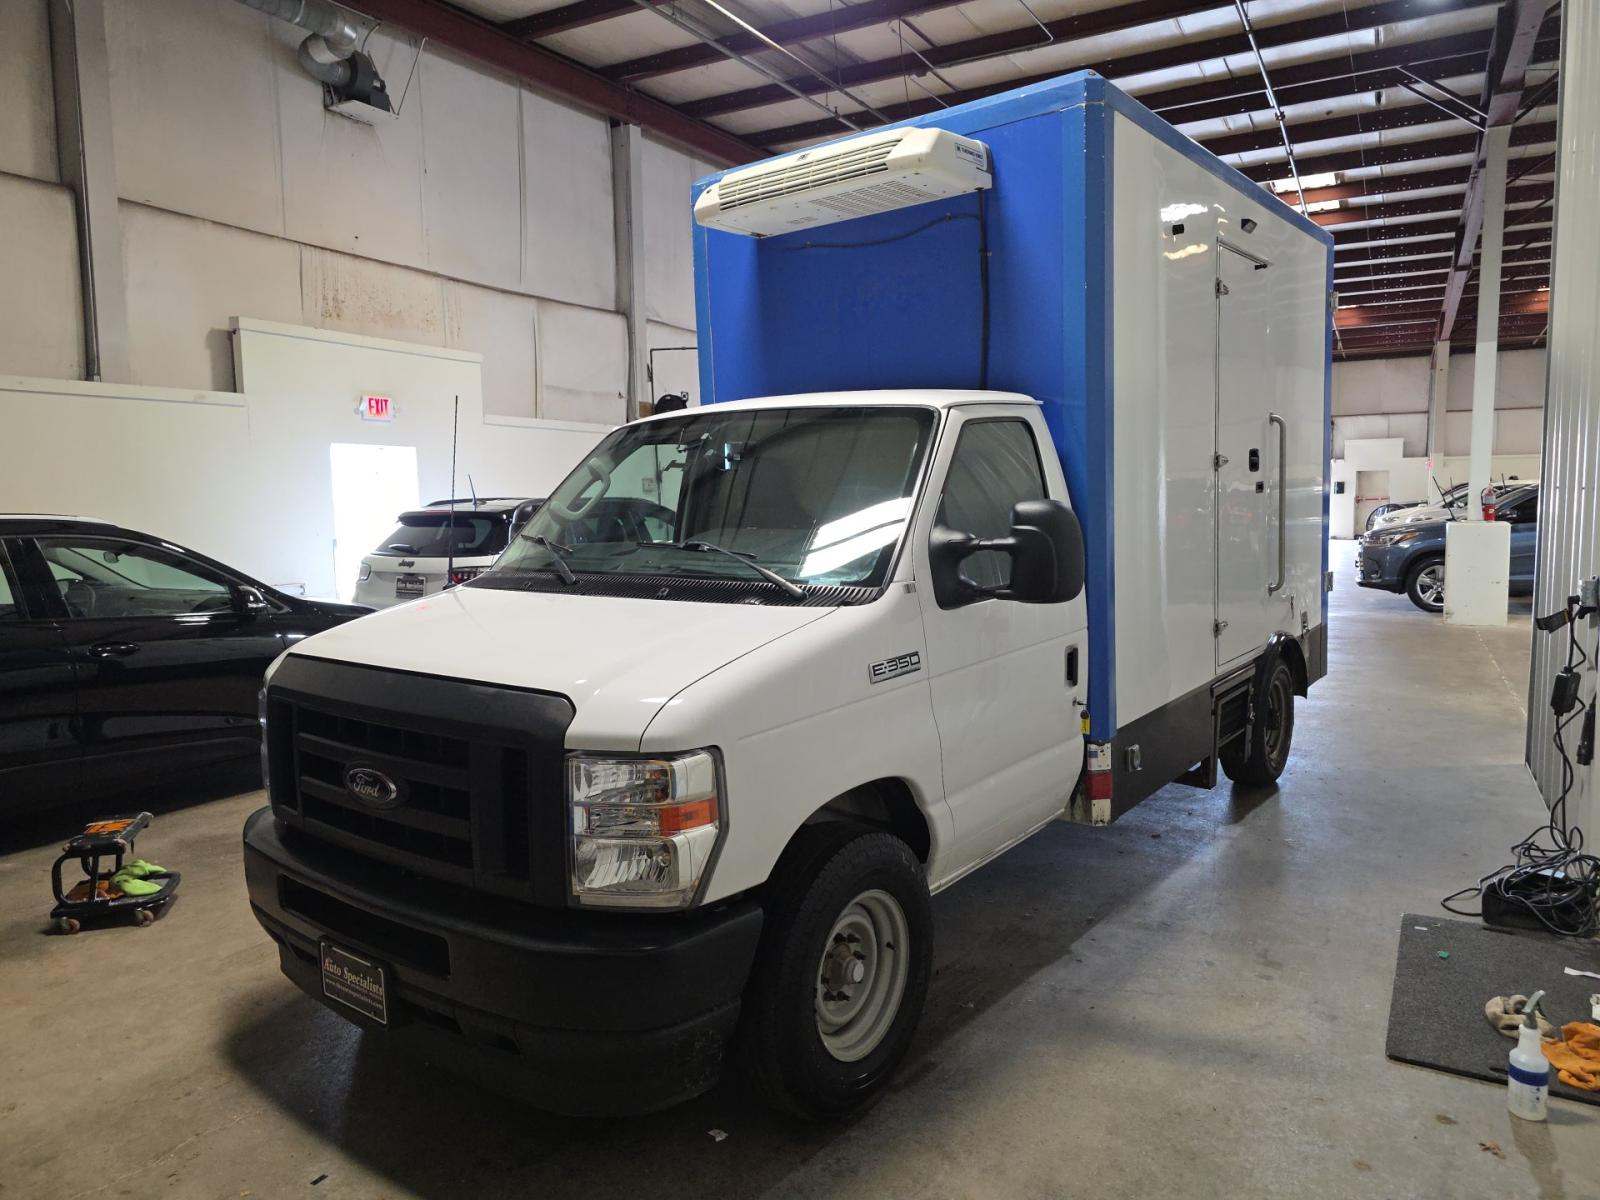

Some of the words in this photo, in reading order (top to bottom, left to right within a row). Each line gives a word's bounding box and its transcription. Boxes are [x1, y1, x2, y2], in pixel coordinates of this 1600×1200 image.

[368, 397, 389, 416] EXIT
[398, 559, 415, 568] Jeep
[353, 773, 380, 798] Ford
[323, 957, 342, 976] Auto
